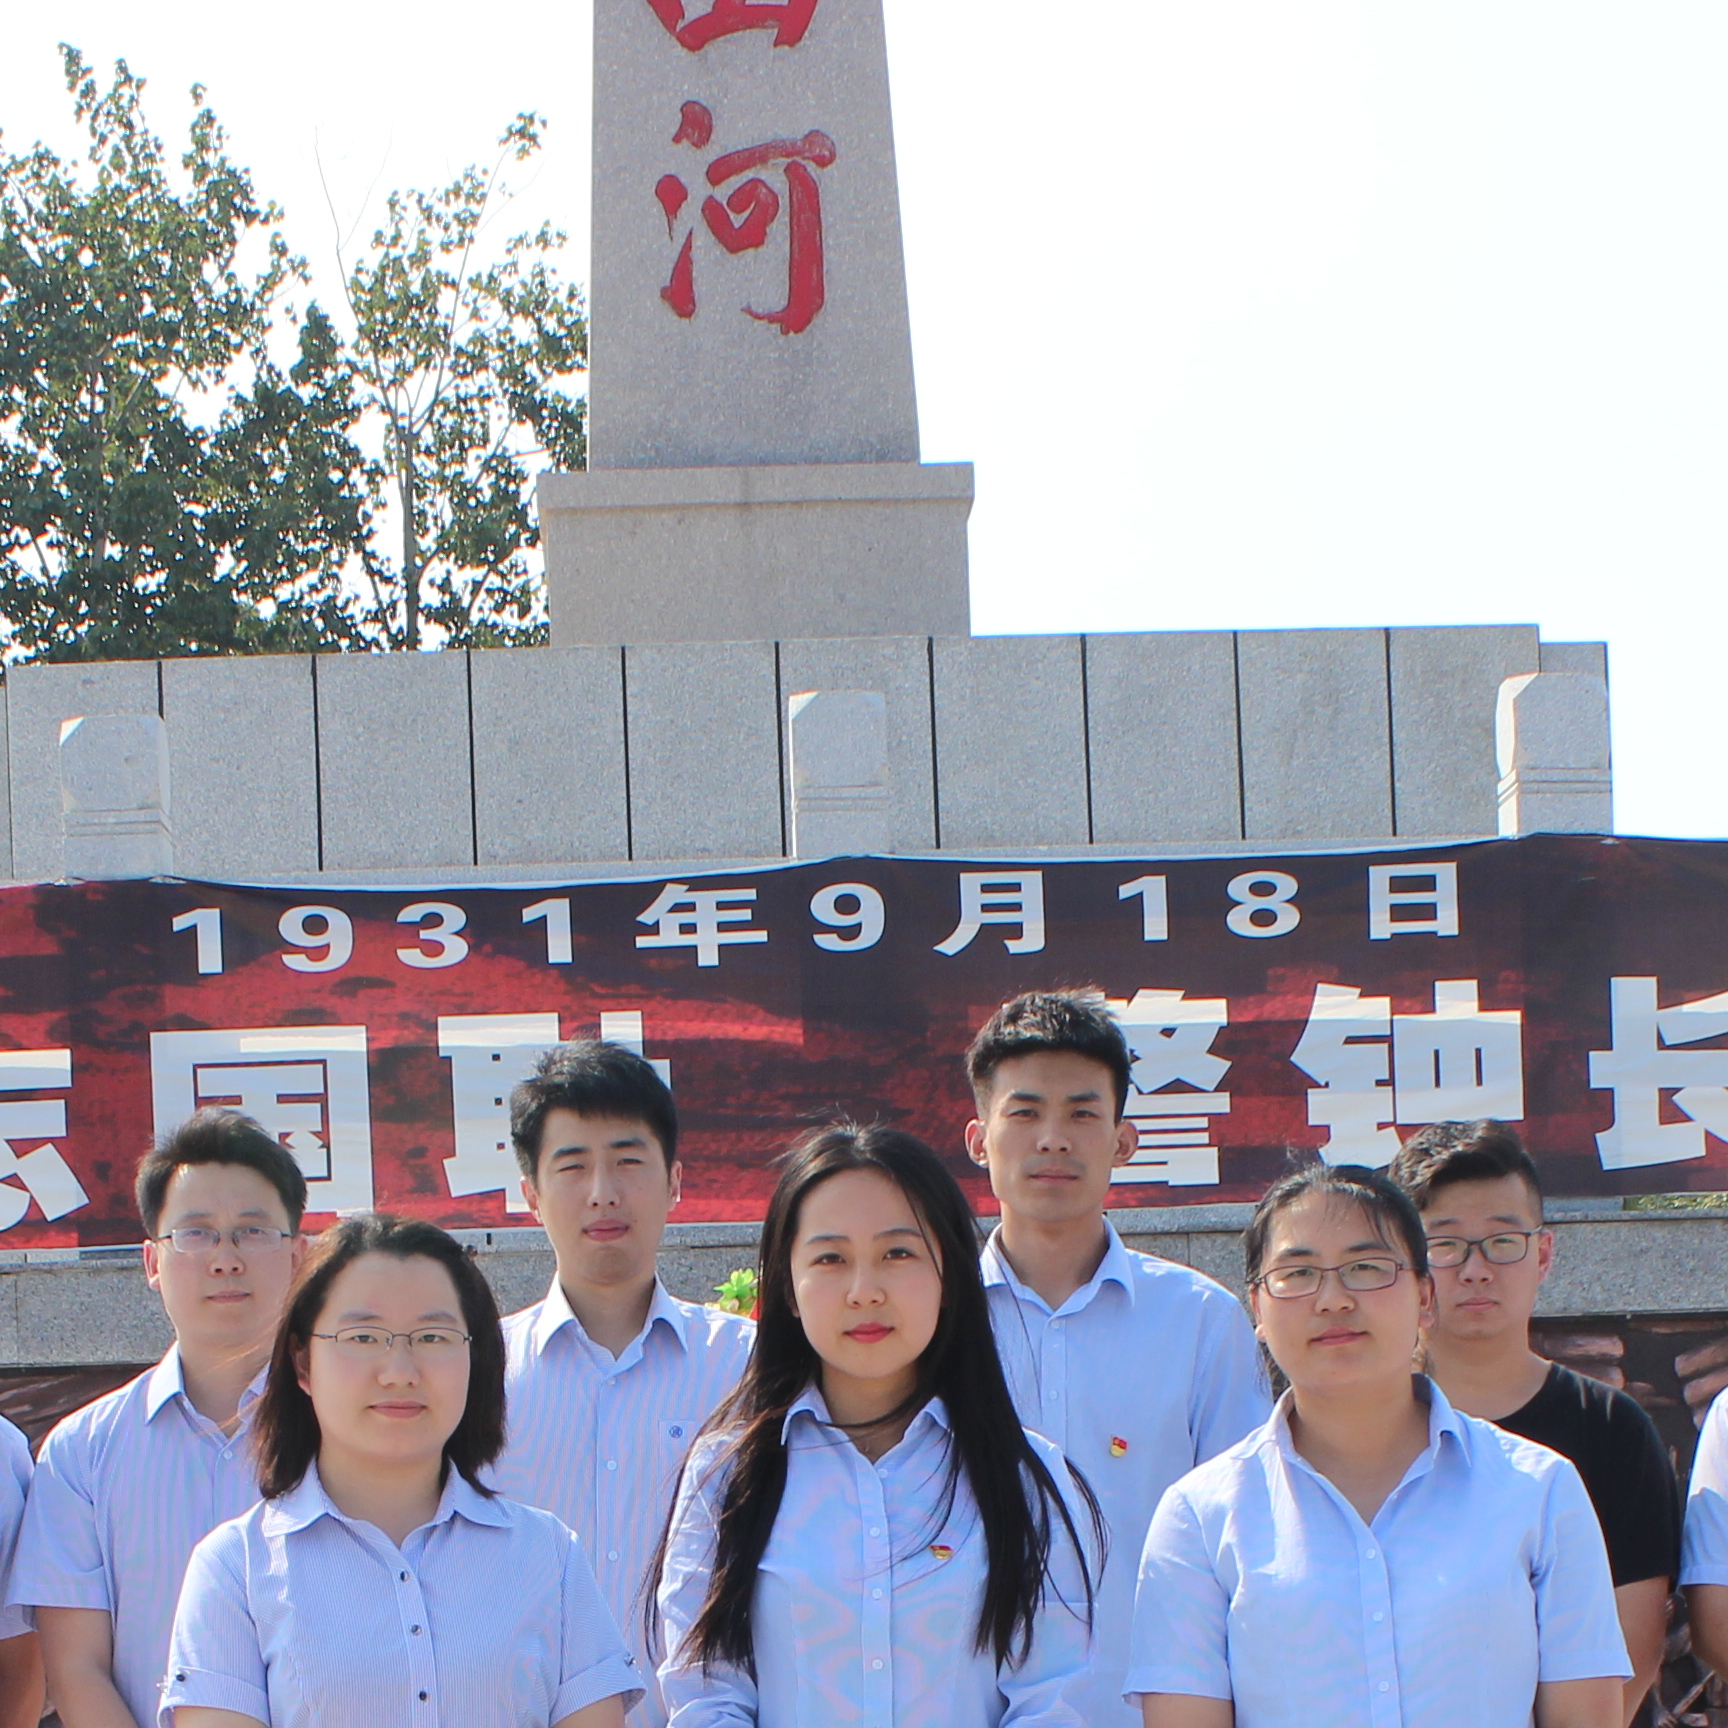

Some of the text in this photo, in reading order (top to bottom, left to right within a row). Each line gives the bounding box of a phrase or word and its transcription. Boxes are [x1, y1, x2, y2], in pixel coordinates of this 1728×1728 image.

[645, 0, 837, 335] 河
[172, 861, 1460, 975] 1931年9月18日
